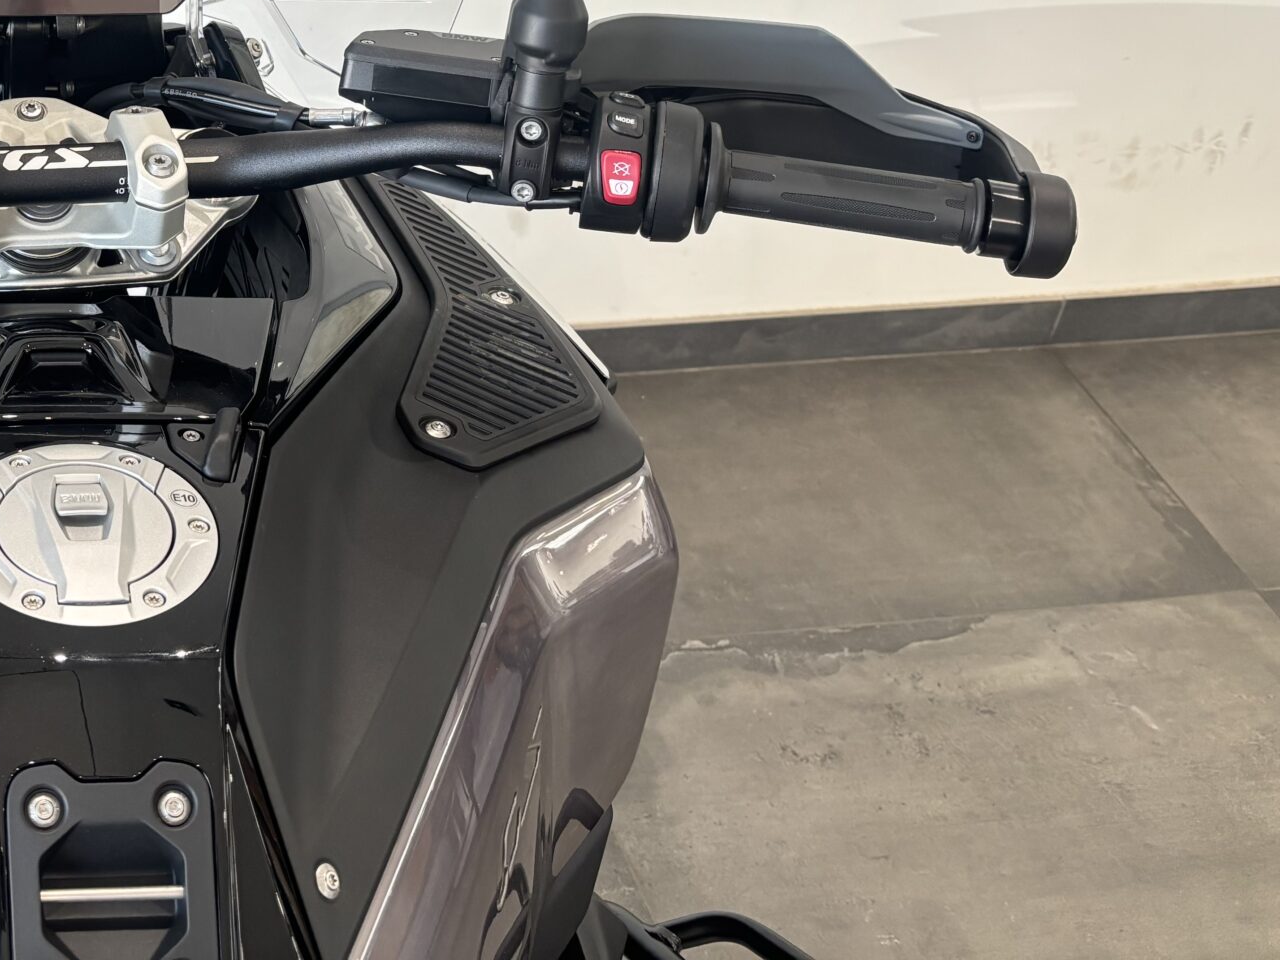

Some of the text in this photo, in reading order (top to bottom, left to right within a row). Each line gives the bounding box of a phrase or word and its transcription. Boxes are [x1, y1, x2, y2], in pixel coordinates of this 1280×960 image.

[615, 114, 635, 125] MODE
[2, 146, 95, 171] GS
[173, 491, 196, 504] E10
